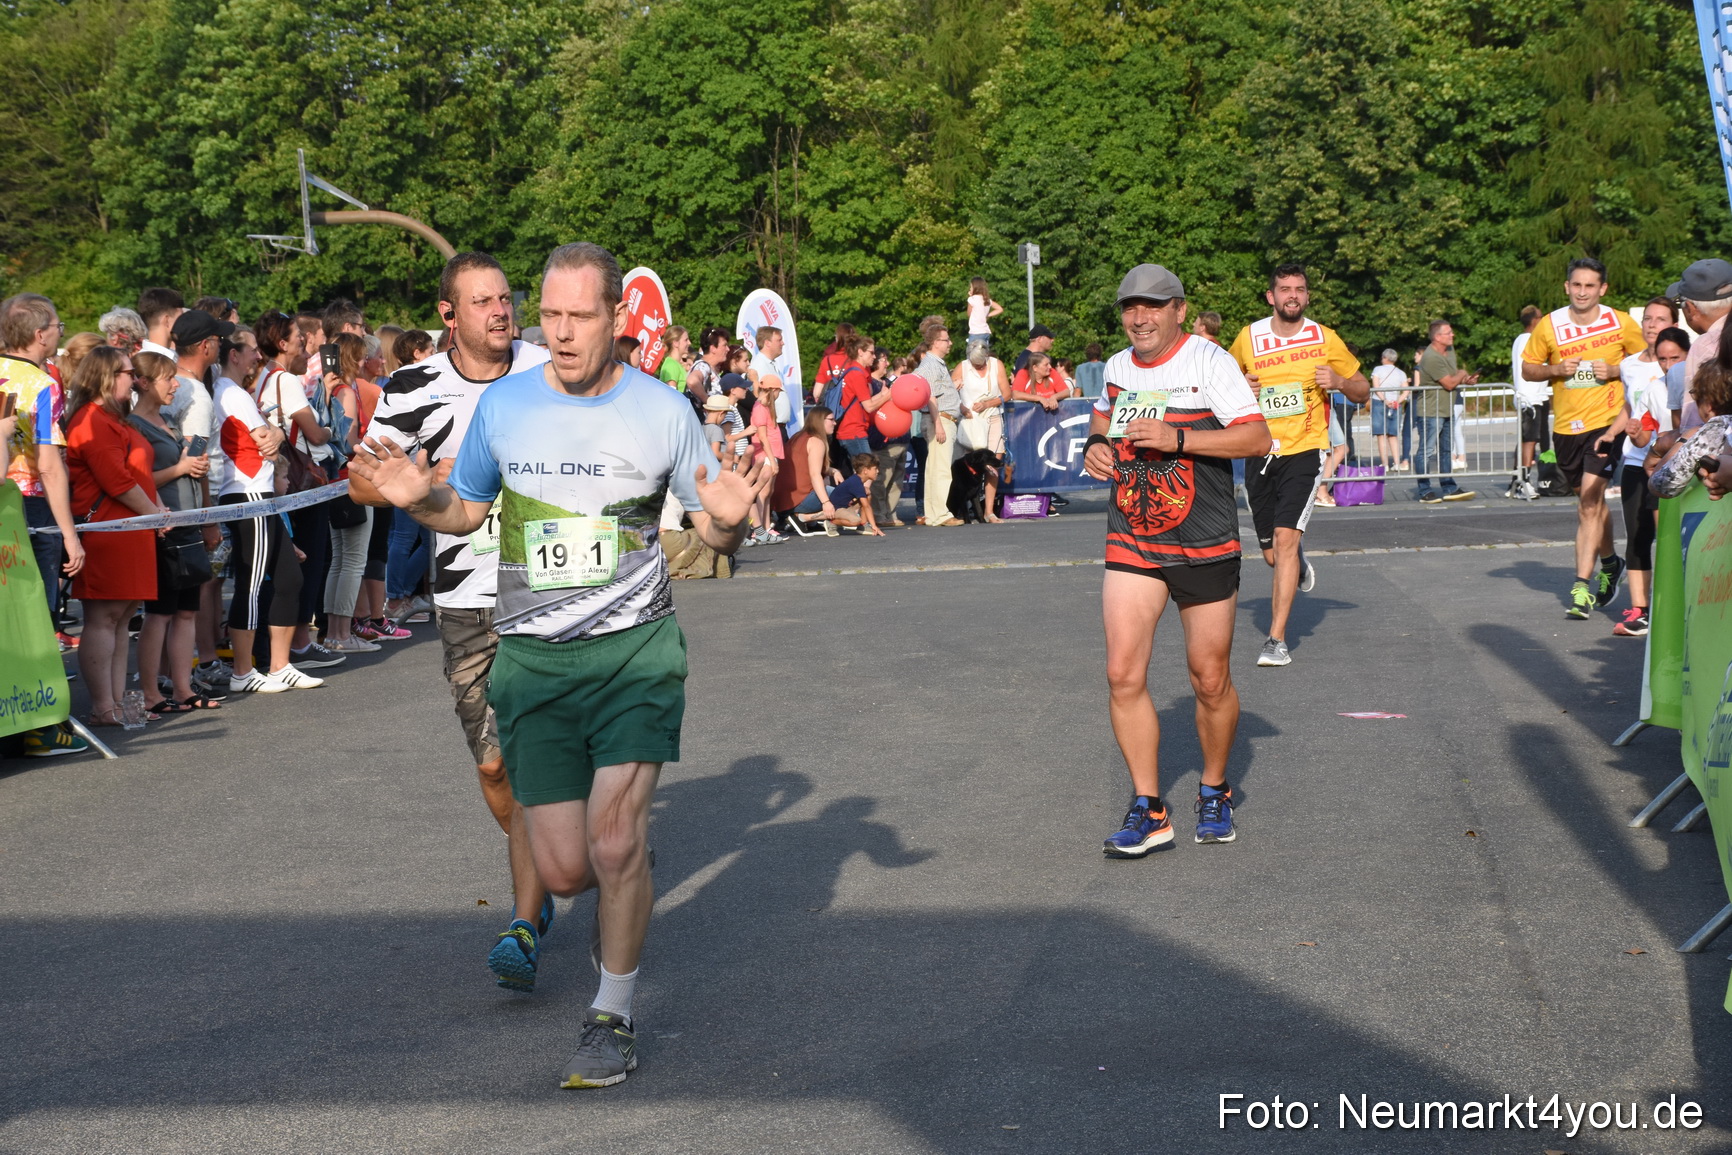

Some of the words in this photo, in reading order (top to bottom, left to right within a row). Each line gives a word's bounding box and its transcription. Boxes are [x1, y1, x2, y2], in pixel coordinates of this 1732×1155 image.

[628, 287, 639, 312] AVIA
[1560, 344, 1587, 357] MAX
[1592, 333, 1624, 349] BÖGL
[1254, 355, 1286, 370] MAX
[1289, 348, 1326, 362] BÖGL
[1572, 370, 1596, 381] 166
[1265, 394, 1298, 409] 1623
[1117, 407, 1157, 424] 2240
[508, 463, 605, 477] RAIL.ONE
[549, 567, 586, 577] Glasenp
